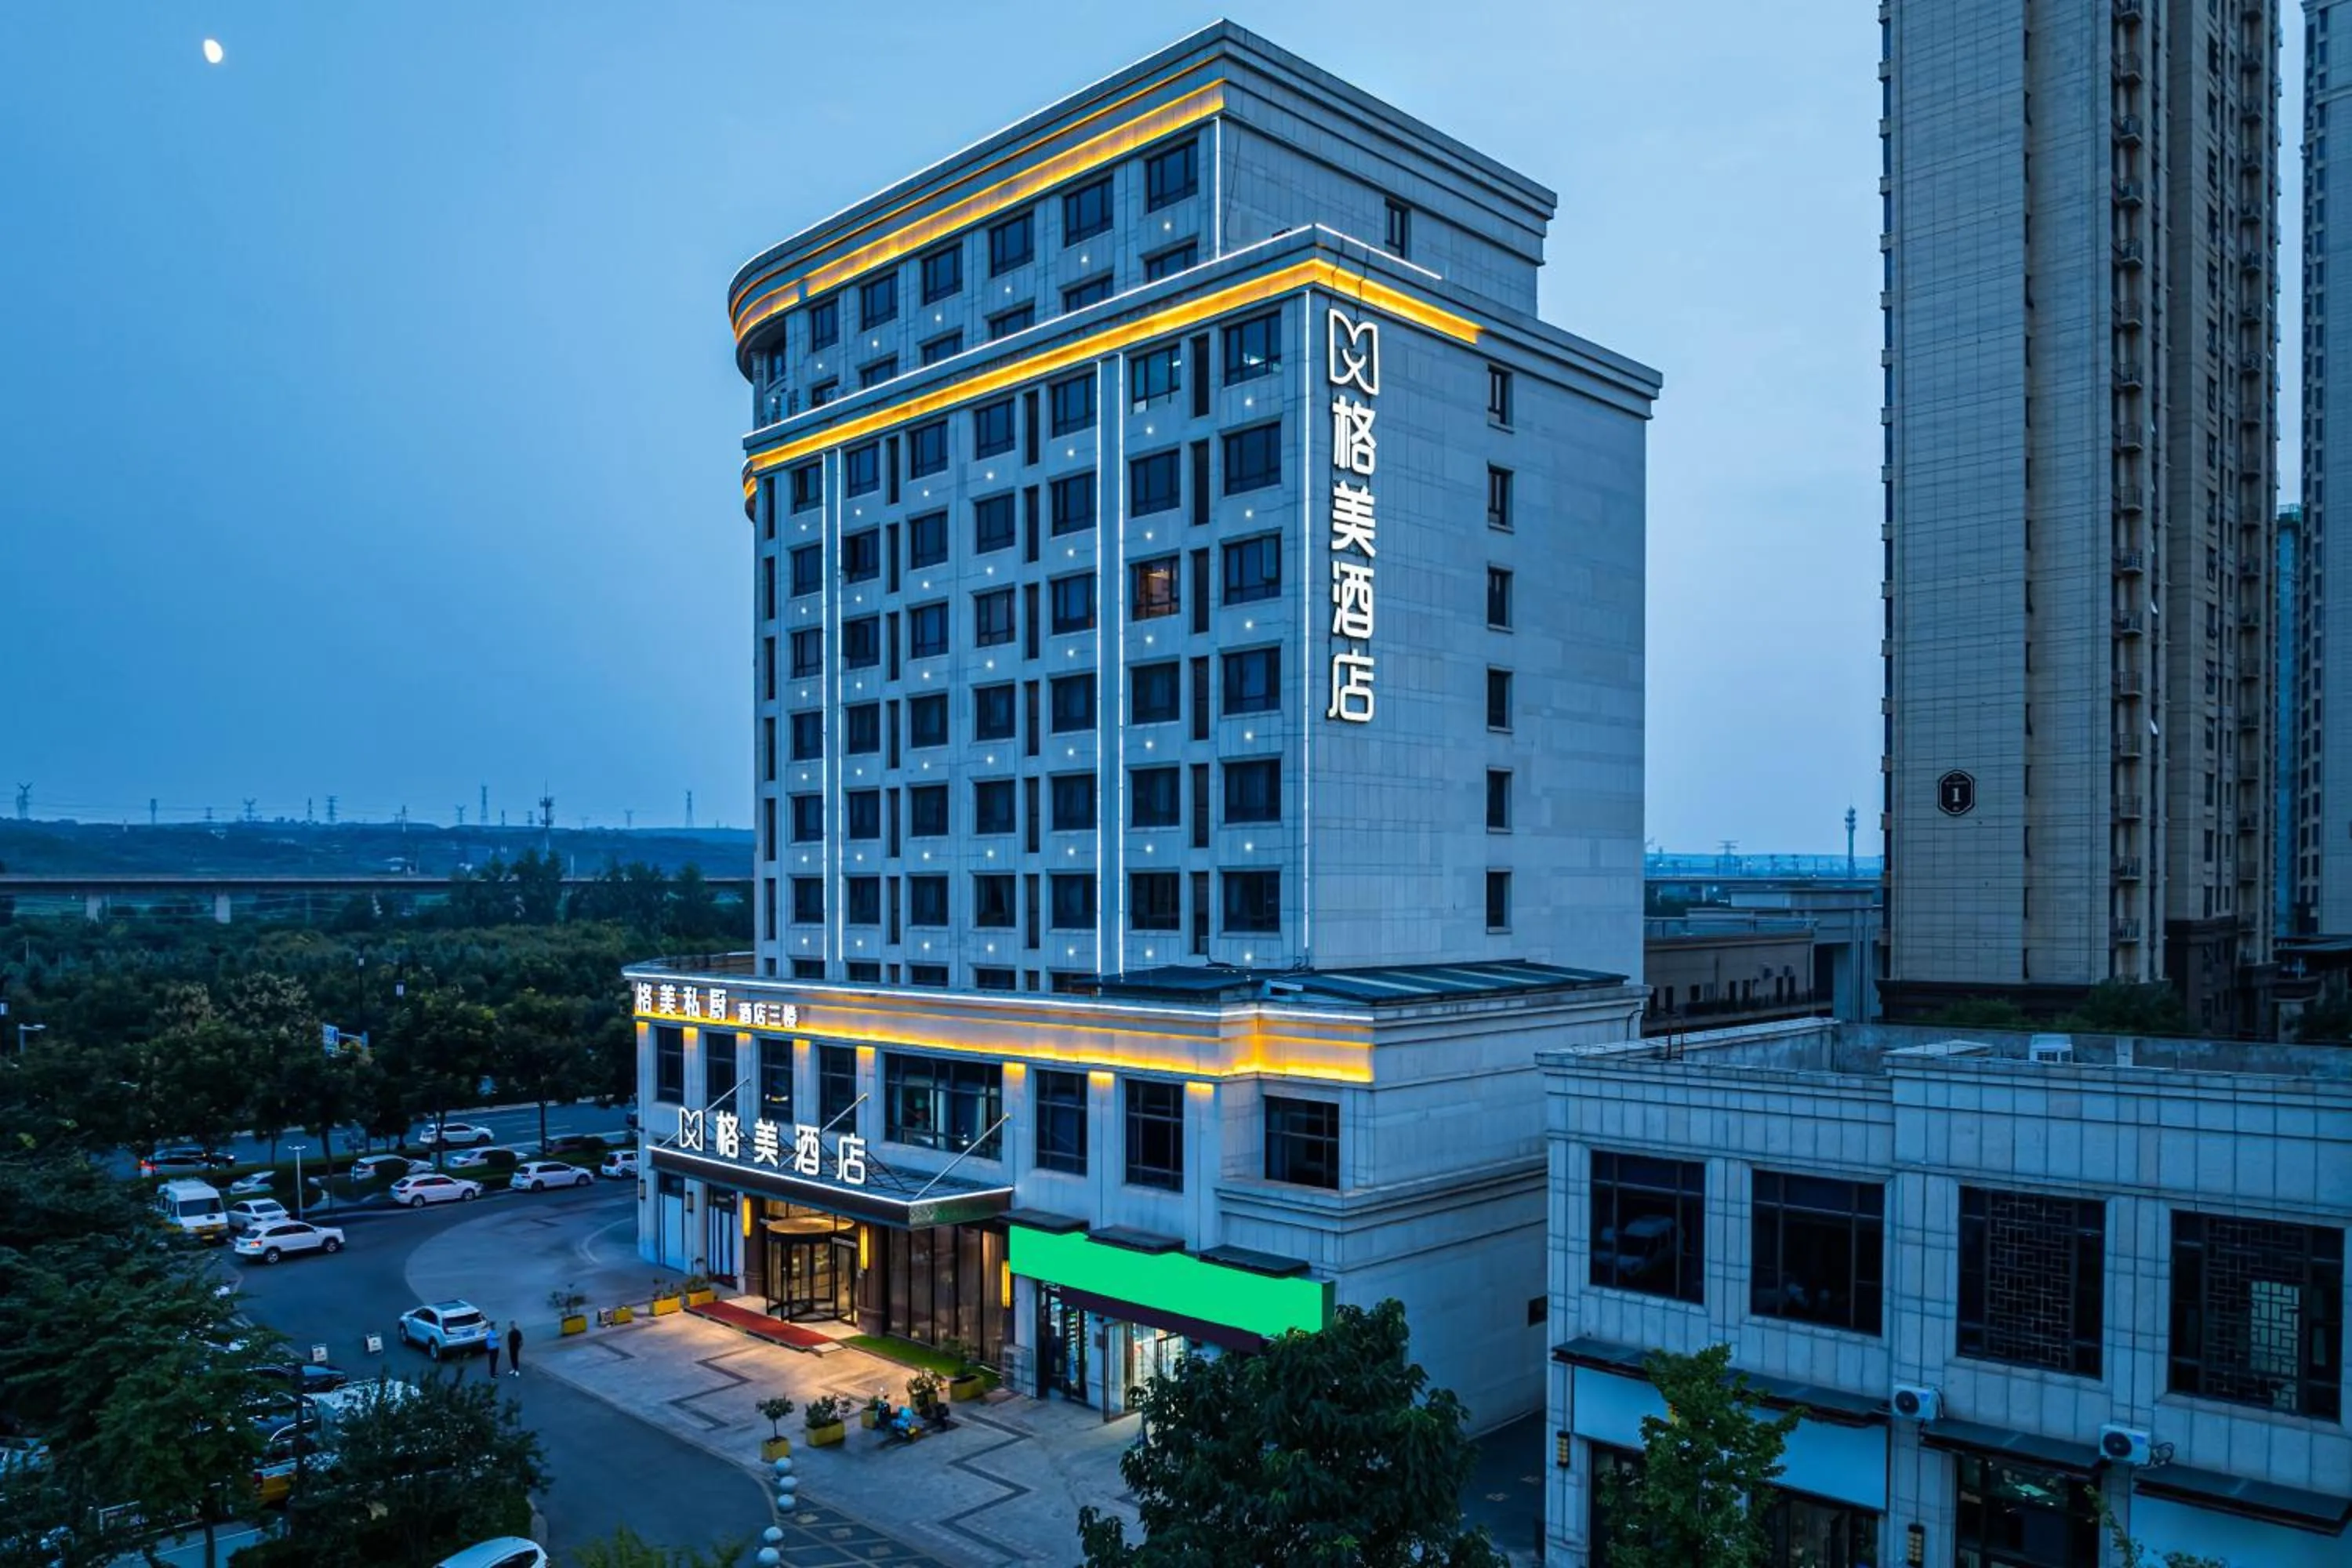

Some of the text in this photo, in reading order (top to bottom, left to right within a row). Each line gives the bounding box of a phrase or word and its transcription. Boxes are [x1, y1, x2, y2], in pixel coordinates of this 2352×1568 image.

[1329, 396, 1377, 722] 格美酒店
[1952, 787, 1961, 802] 1
[636, 982, 797, 1029] 格美私厨 酒店三楼
[716, 1110, 866, 1185] 格美酒店
